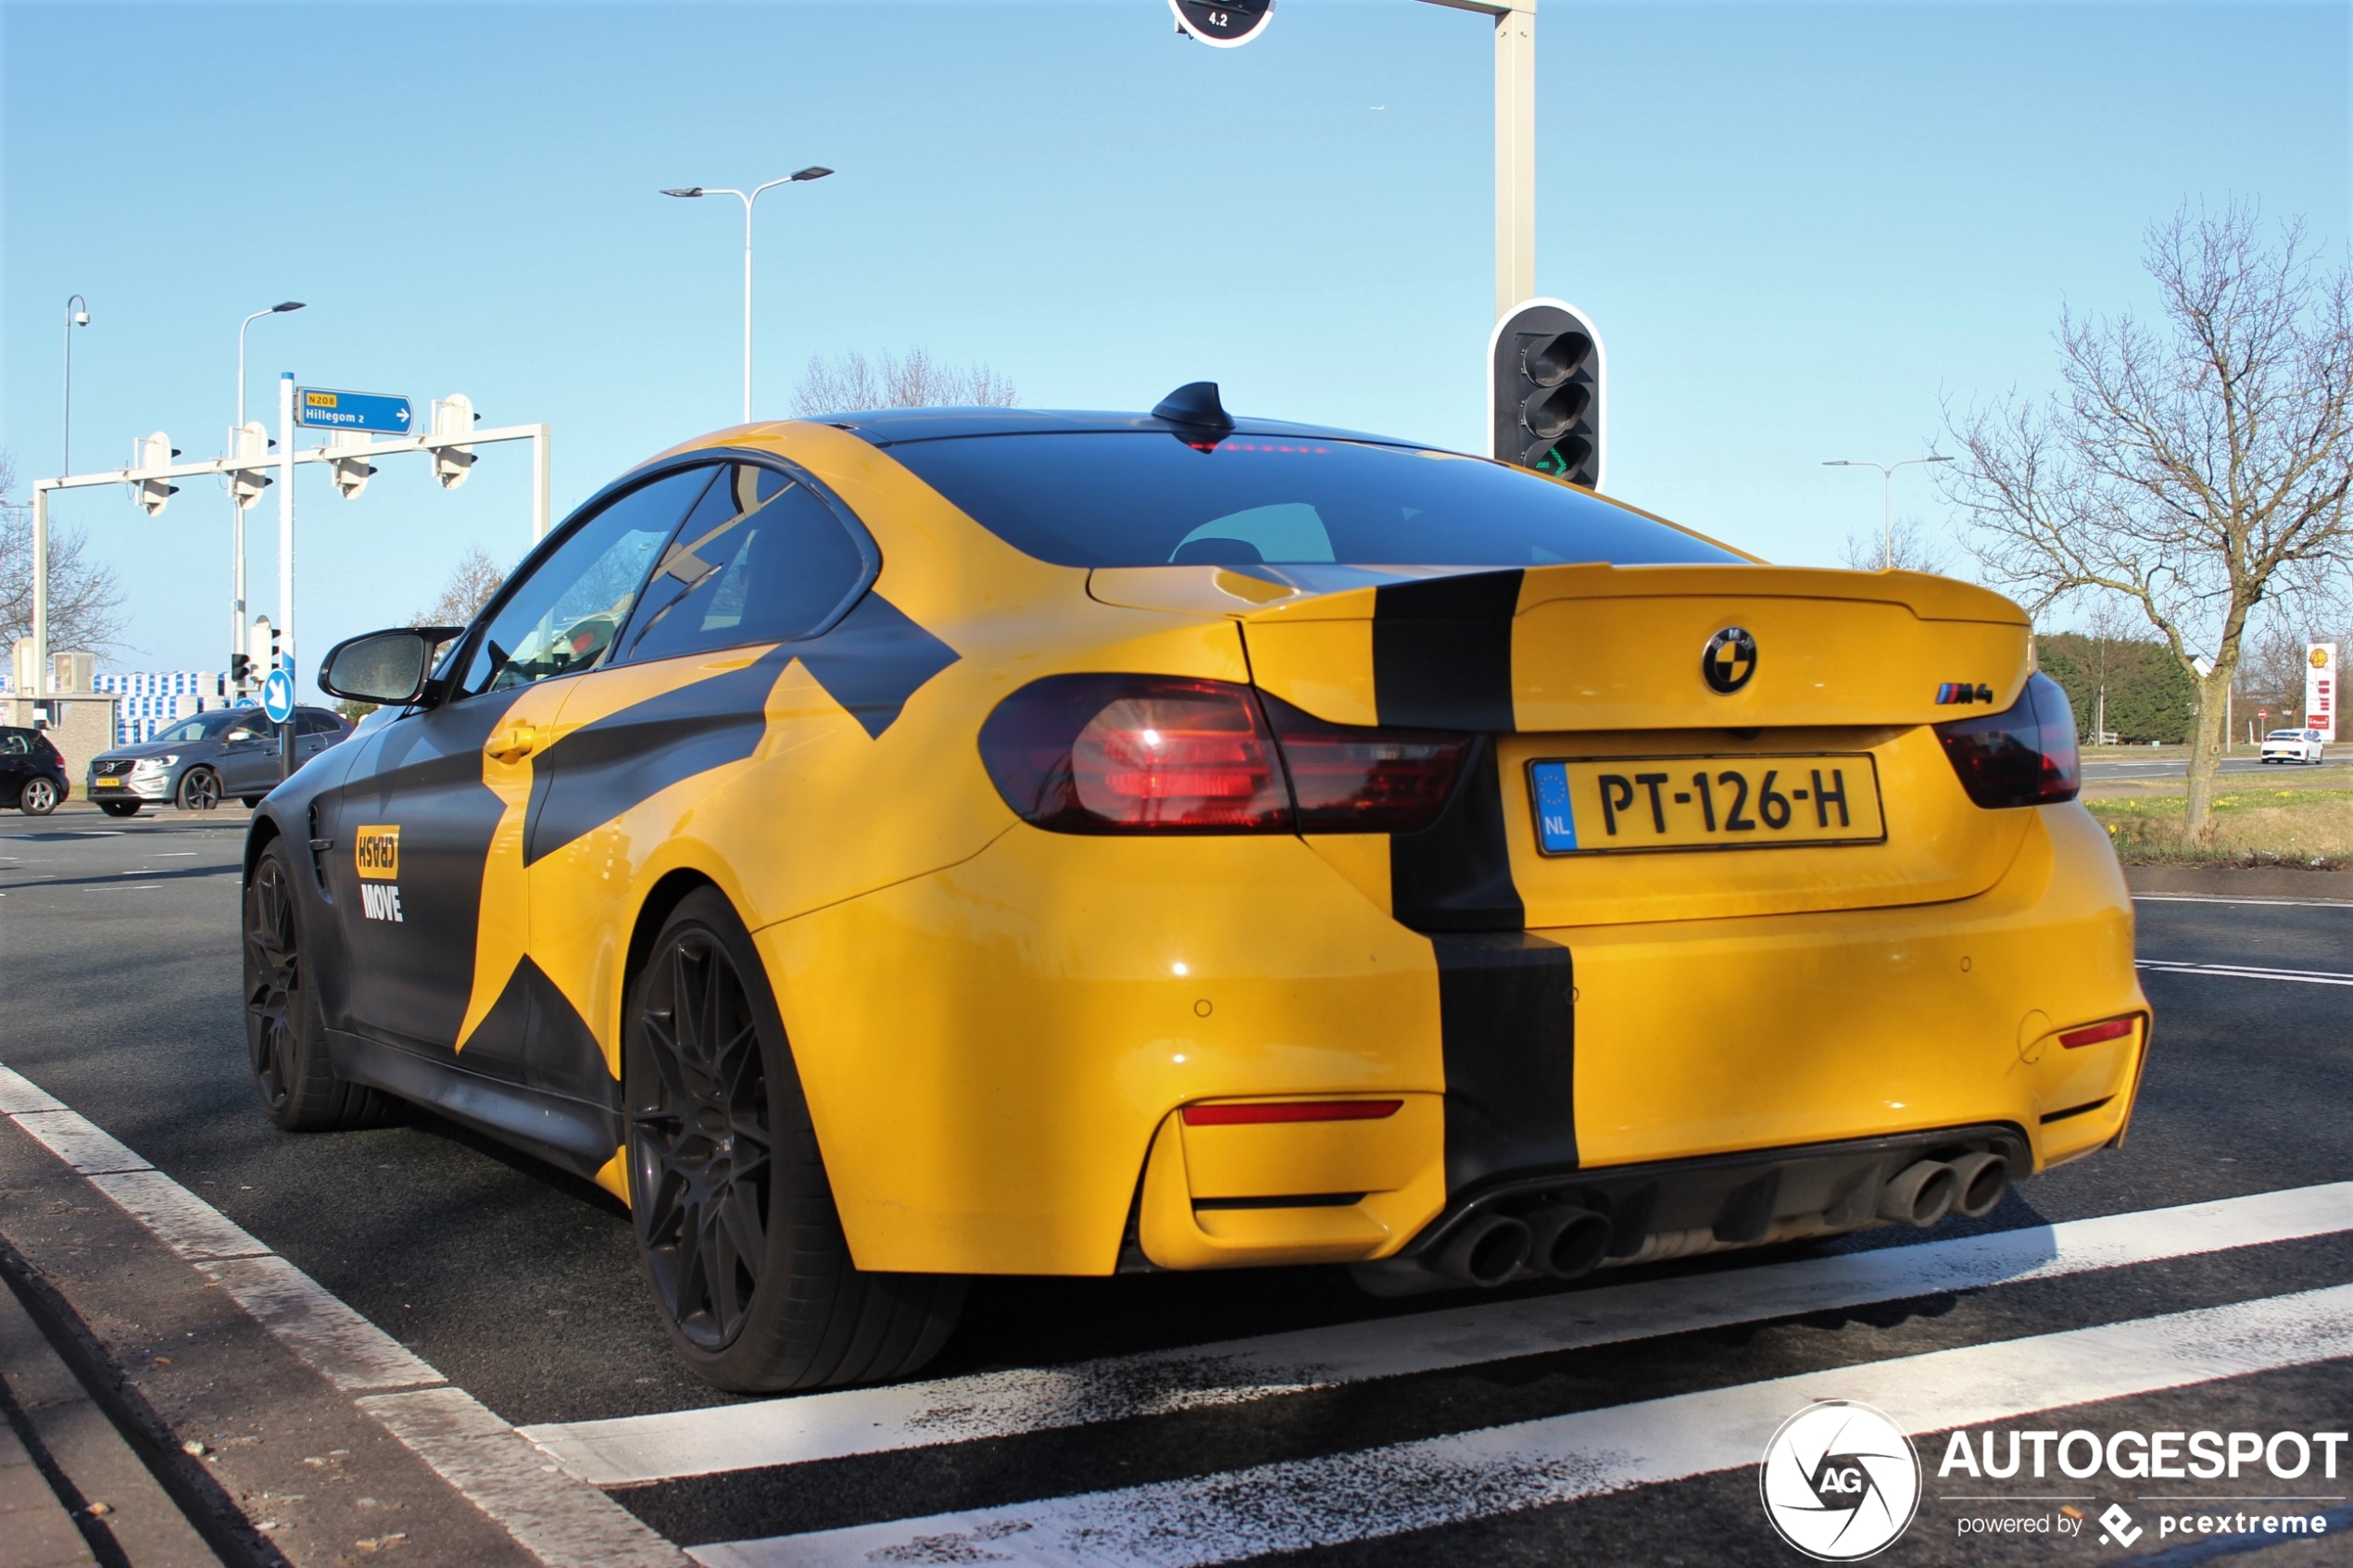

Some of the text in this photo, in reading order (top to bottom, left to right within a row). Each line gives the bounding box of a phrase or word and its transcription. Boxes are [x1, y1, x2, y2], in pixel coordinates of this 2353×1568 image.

[1208, 11, 1228, 28] 4.2
[308, 395, 335, 406] N208
[306, 408, 365, 423] Hillegom 2
[1710, 628, 1755, 650] BMW
[1949, 683, 1993, 705] M4
[1598, 770, 1850, 835] PT-126-H
[1544, 816, 1570, 835] NL
[360, 884, 404, 922] MOVE
